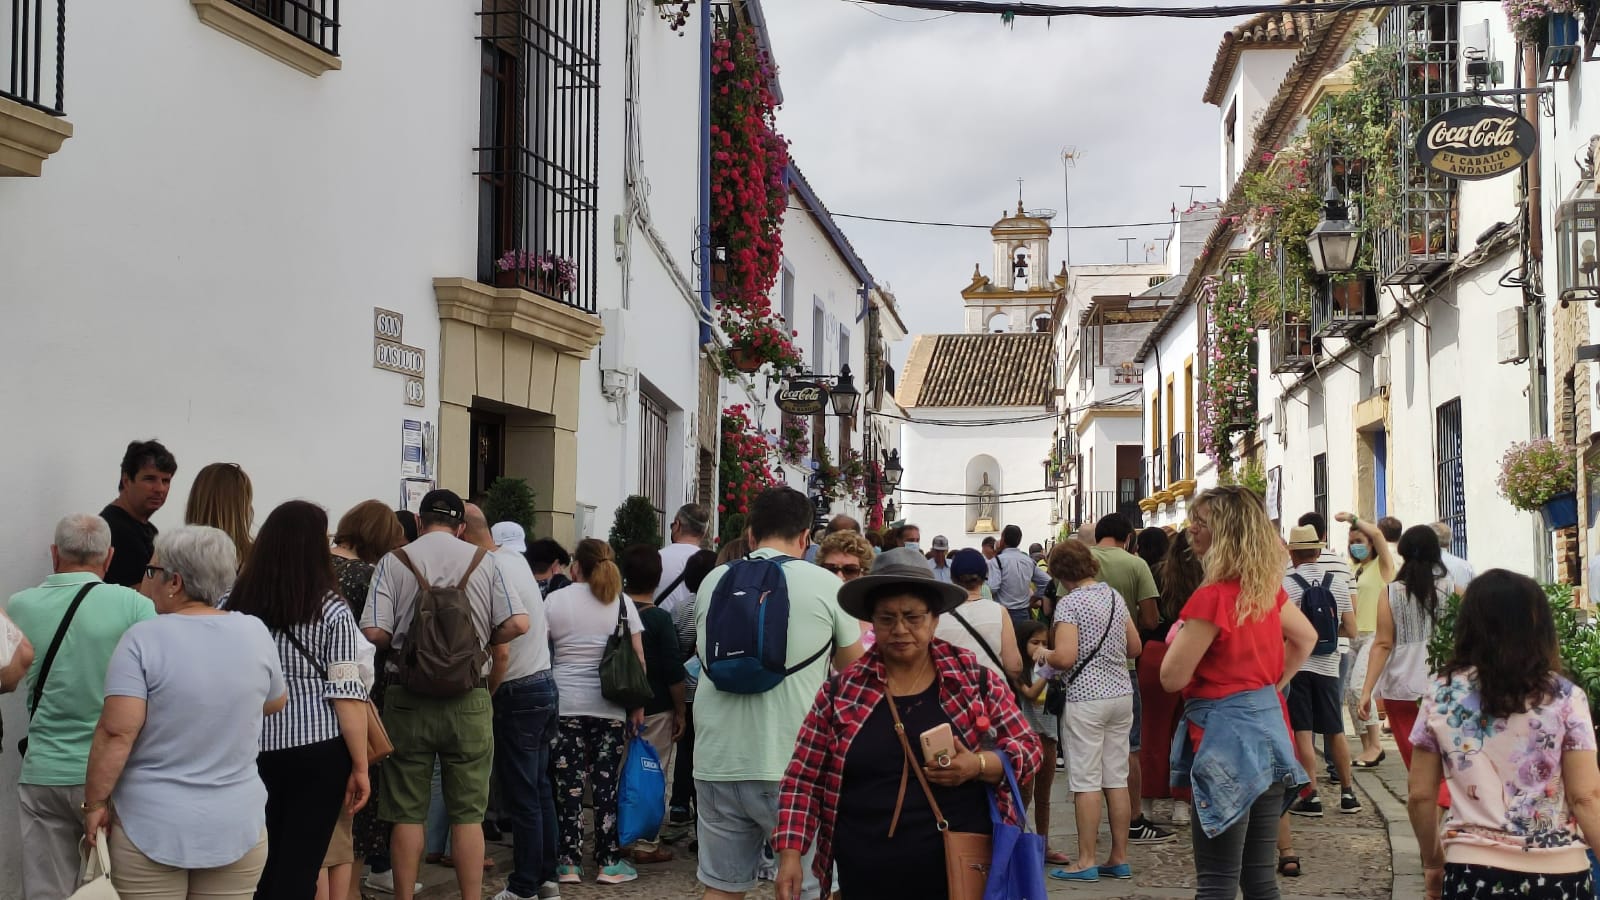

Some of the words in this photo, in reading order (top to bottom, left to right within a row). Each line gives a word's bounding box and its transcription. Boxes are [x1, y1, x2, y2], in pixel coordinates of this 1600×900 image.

[1427, 116, 1517, 150] Coca-Cola
[1442, 153, 1455, 162] EL
[1459, 150, 1511, 166] CABALLO
[1449, 161, 1506, 174] ANDALUZ
[380, 315, 399, 336] SAN
[379, 345, 421, 370] BASILIO
[410, 383, 421, 399] 15
